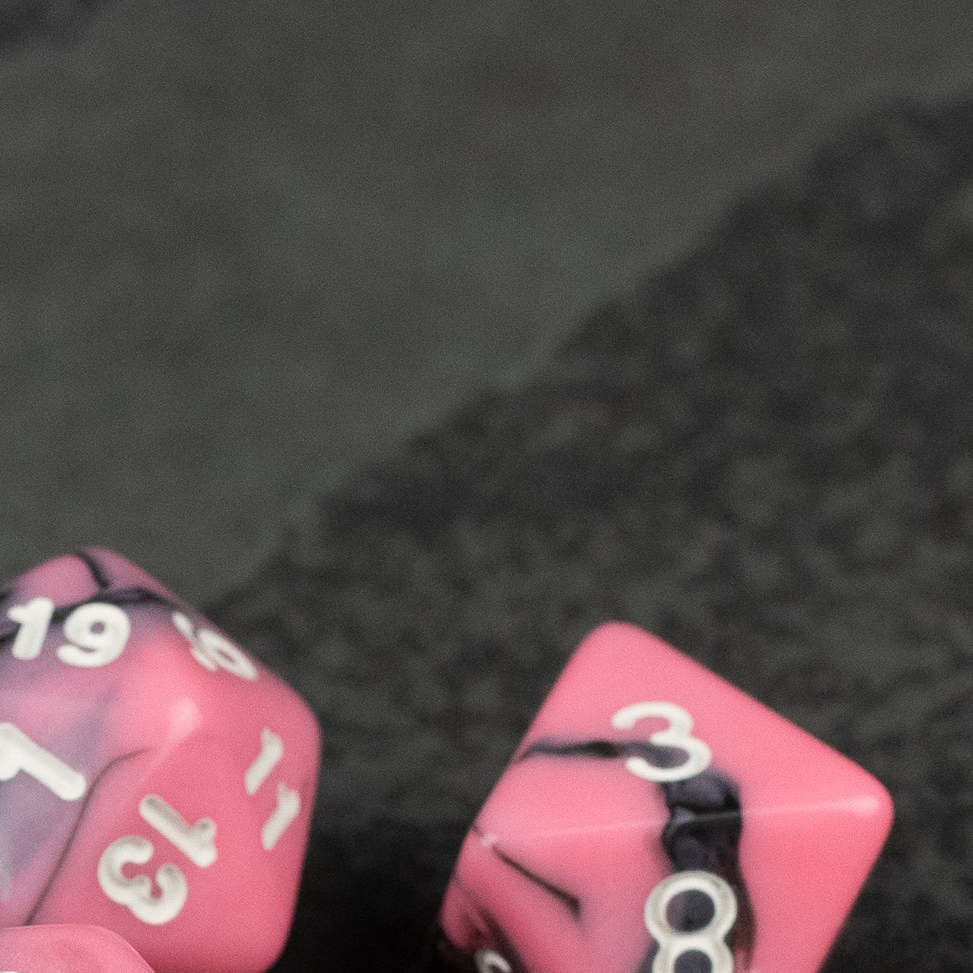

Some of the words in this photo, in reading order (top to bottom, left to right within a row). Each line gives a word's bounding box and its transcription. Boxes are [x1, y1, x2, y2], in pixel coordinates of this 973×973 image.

[6, 597, 132, 668] 19
[611, 701, 712, 783] 3
[97, 795, 218, 925] 13
